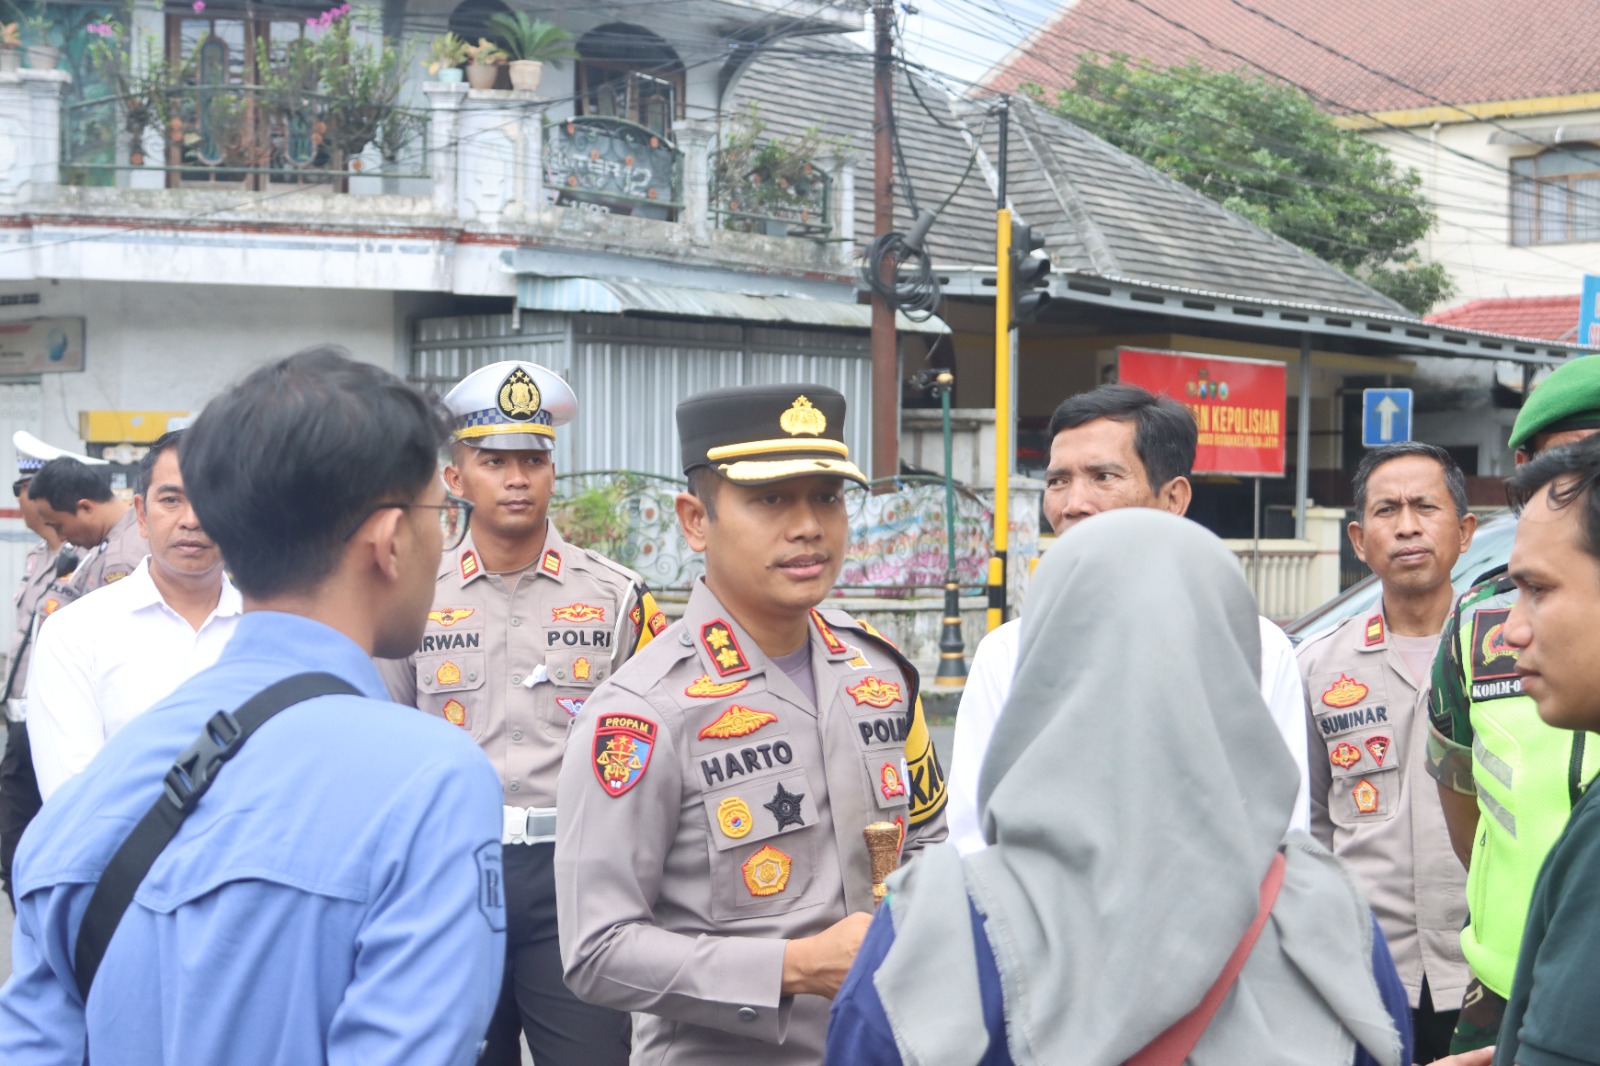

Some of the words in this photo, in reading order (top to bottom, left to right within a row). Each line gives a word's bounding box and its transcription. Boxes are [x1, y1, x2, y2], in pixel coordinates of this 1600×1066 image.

[1187, 403, 1209, 432] AN
[1211, 405, 1279, 435] KEPOLISIAN
[547, 629, 612, 649] POLRI
[1472, 680, 1521, 698] KODIM-0
[605, 717, 649, 733] PROPAM
[1320, 705, 1389, 735] SUMINAR
[700, 740, 793, 786] HARTO
